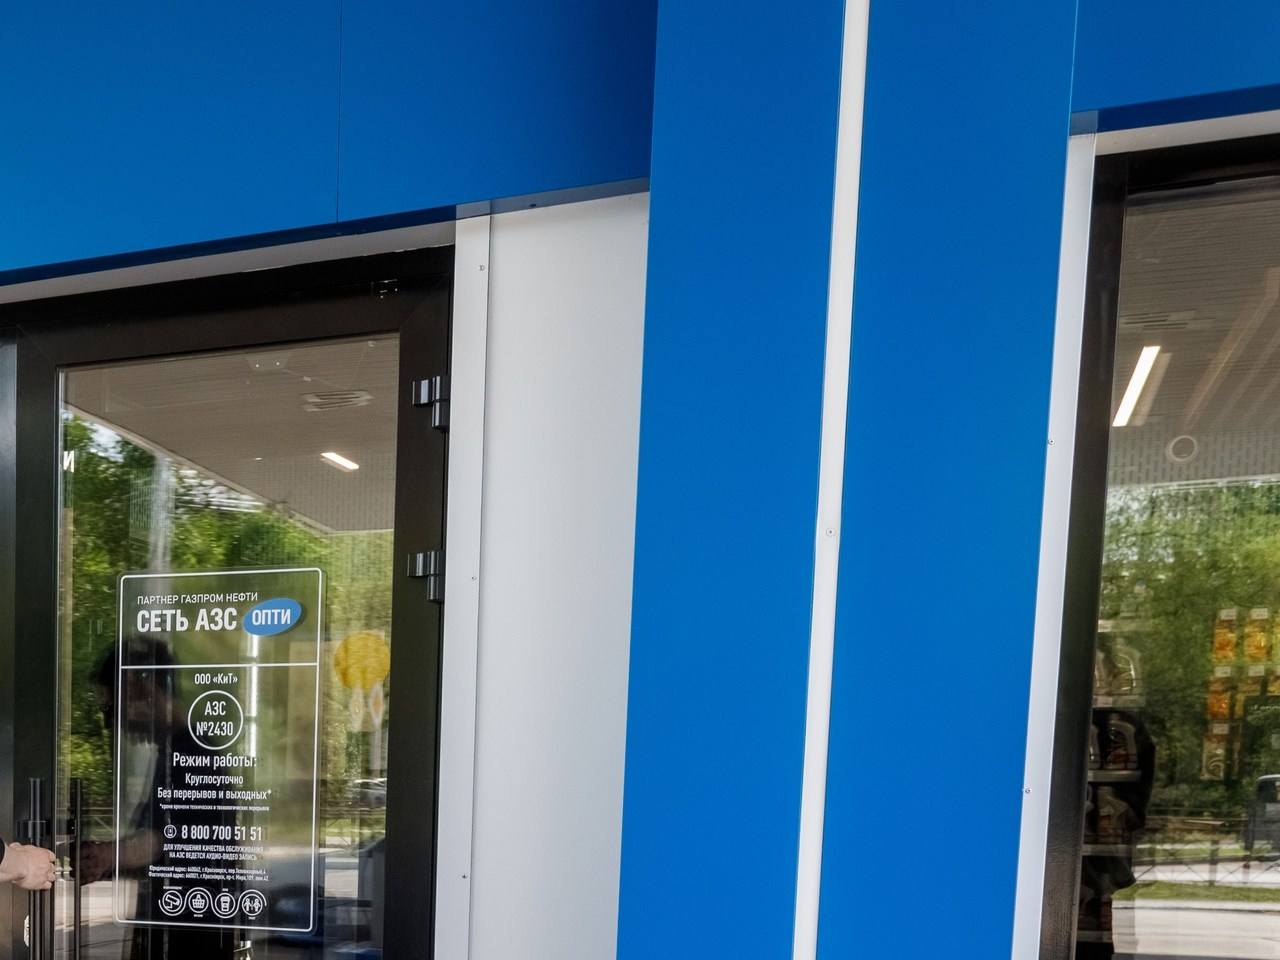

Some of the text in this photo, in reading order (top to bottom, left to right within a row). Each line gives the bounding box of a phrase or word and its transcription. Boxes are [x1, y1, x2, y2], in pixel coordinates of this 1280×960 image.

[137, 592, 258, 605] ПАРТНЕР ГАЗПРОМ НЕФТИ
[137, 607, 291, 633] СЕТЬ АЗС ОПТИ
[194, 672, 238, 685] ООО «КиТ»
[204, 701, 227, 716] АЗС
[196, 721, 234, 736] №2430
[173, 752, 257, 771] Режим работы:
[185, 772, 244, 787] Круглосуточно
[157, 787, 172, 798] Без
[173, 789, 217, 801] перерывов
[218, 790, 224, 799] и
[181, 824, 262, 841] 8 800 700 51 51
[163, 843, 264, 853] ДЛЯ УЛУЧШЕНИЯ КАЧЕСТВА ОБСЛУЖИВАНИЯ
[176, 851, 185, 859] АЗС
[185, 852, 206, 860] ВЕДЕТСЯ
[206, 853, 239, 861] АУДИО-ВИДЕО
[239, 853, 258, 861] ЗАПИСЬ
